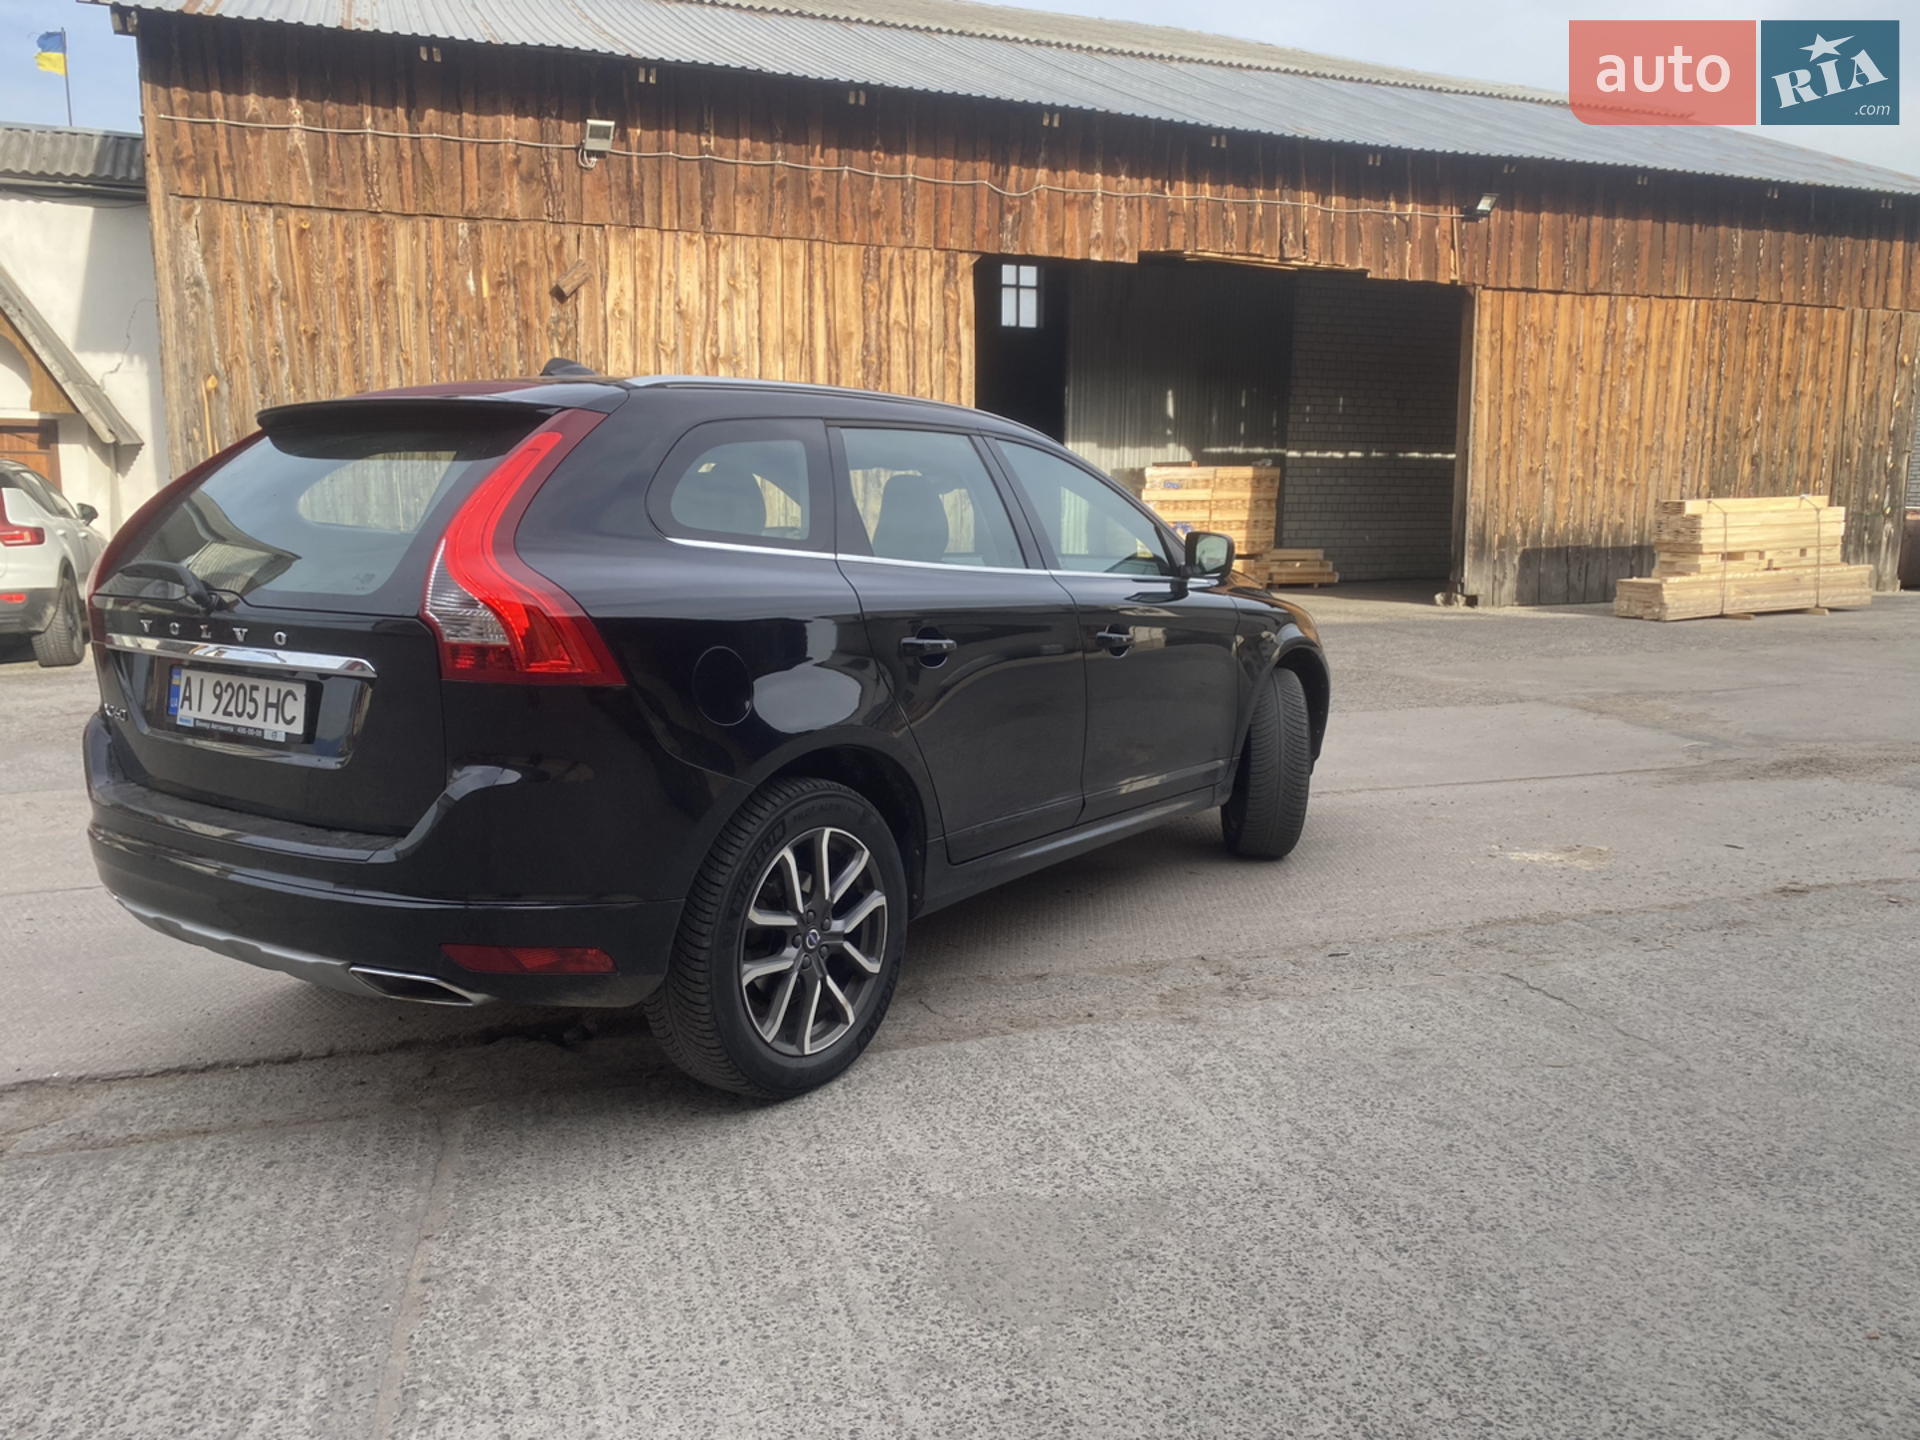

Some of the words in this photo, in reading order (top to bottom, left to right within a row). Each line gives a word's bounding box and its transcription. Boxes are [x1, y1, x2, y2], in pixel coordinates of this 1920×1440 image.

[140, 619, 288, 646] VOLVO
[211, 680, 259, 720] 9205
[263, 686, 298, 726] HC
[729, 820, 785, 914] MICHELIN
